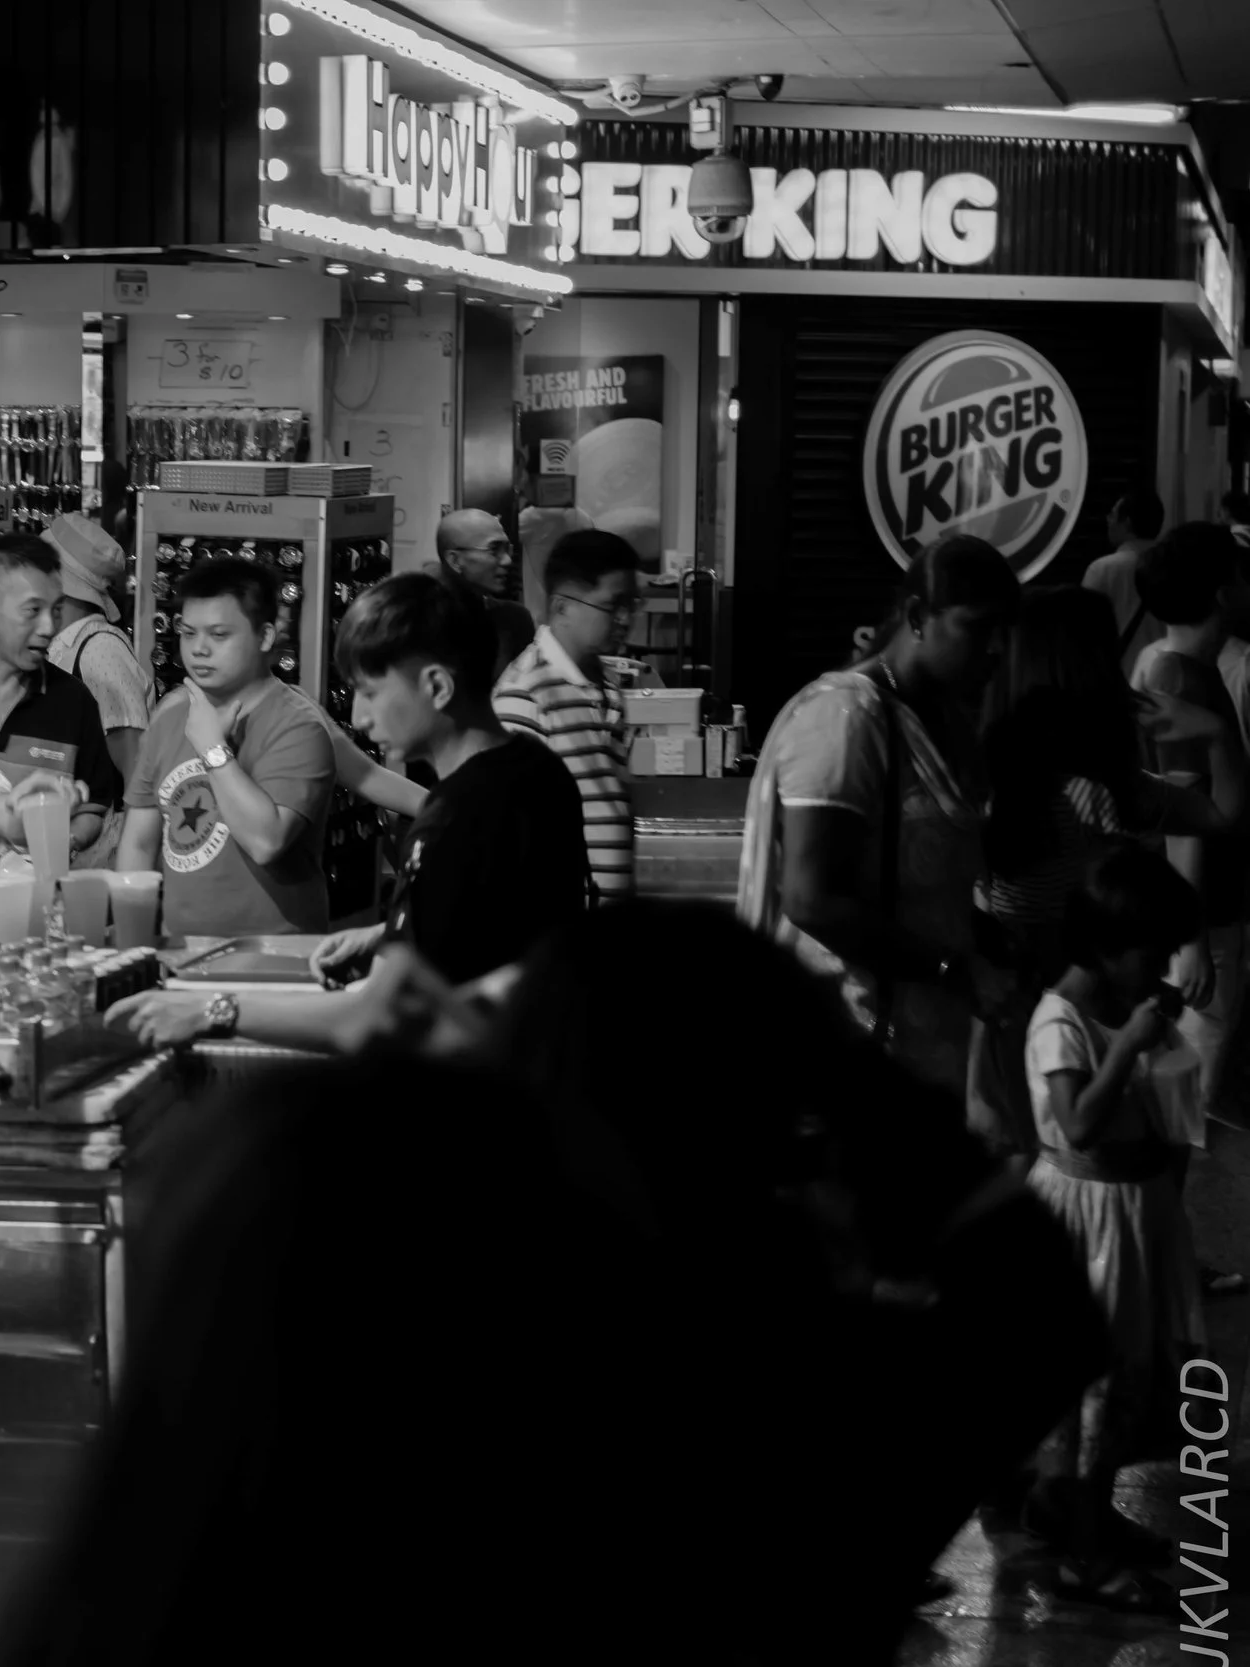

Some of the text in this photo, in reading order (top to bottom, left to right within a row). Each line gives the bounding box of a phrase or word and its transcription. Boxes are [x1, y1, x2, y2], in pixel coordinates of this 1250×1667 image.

[318, 54, 472, 232] Happy
[562, 162, 998, 266] ER KING
[166, 342, 191, 367] 3
[524, 366, 627, 394] FRESH AND
[522, 386, 628, 413] FLAVOURFUL
[899, 384, 1057, 475] BURGER
[188, 498, 273, 515] New Arrival
[903, 426, 1064, 540] KING
